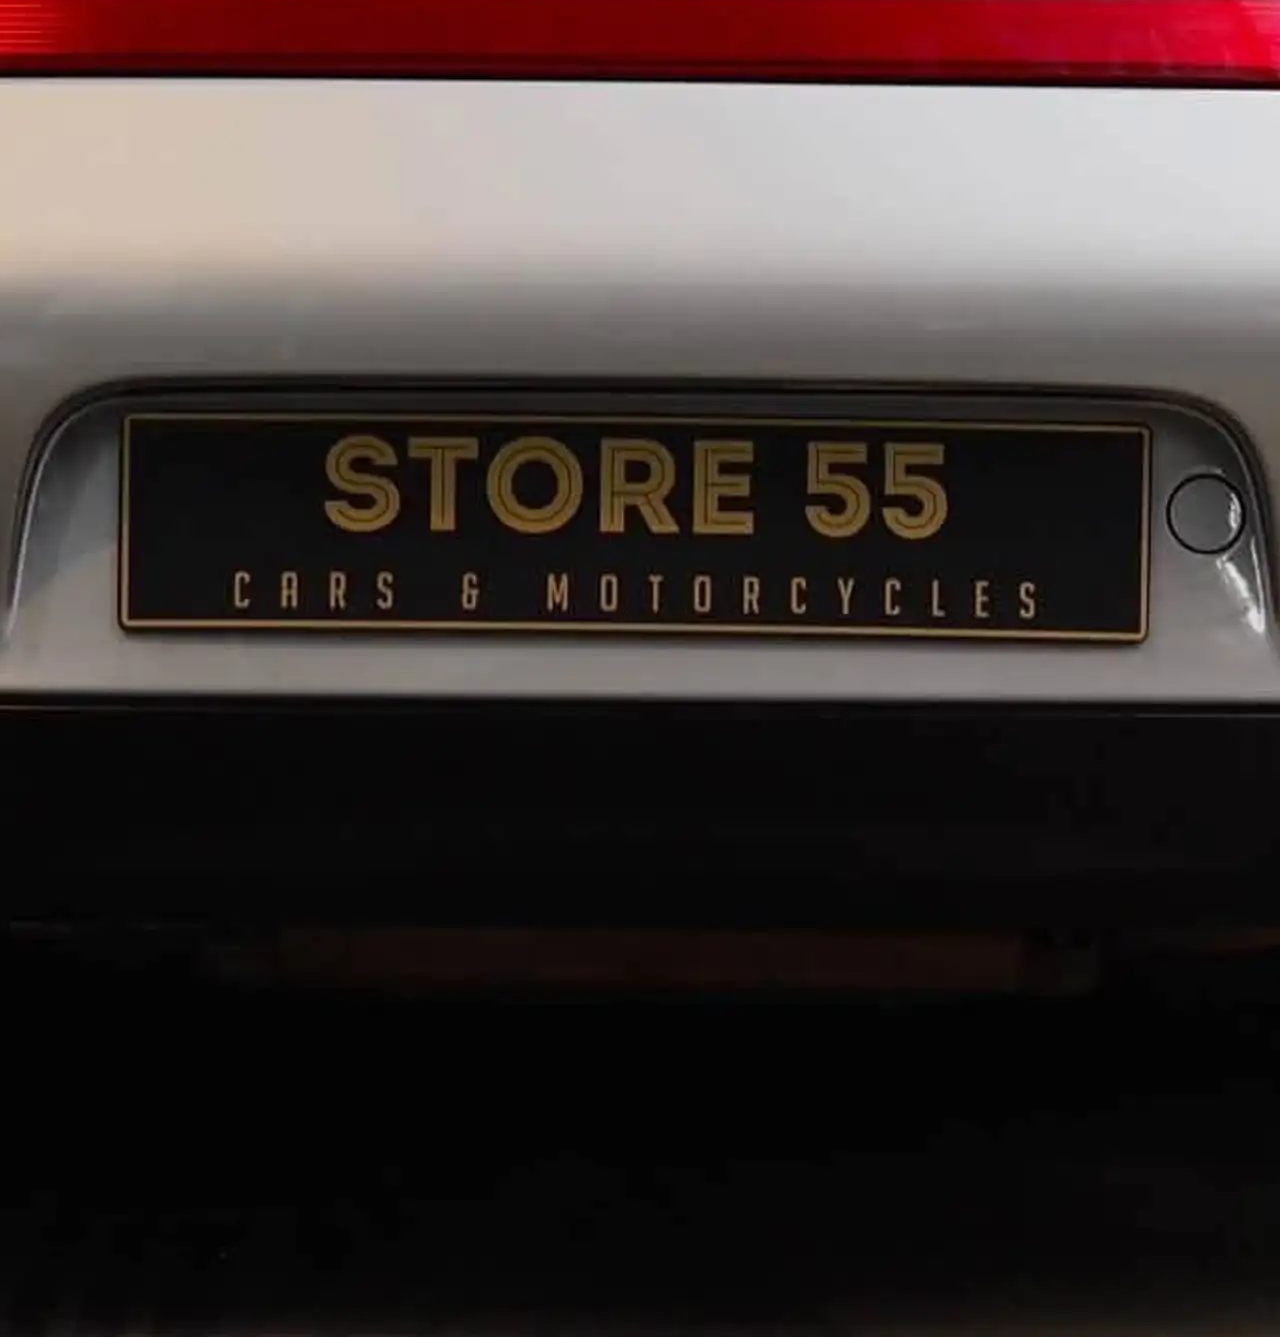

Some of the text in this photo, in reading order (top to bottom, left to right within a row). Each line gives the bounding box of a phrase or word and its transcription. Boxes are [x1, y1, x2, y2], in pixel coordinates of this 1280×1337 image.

[324, 434, 949, 541] STORE 55
[233, 569, 1039, 620] CARS & MOTORCYCLES
